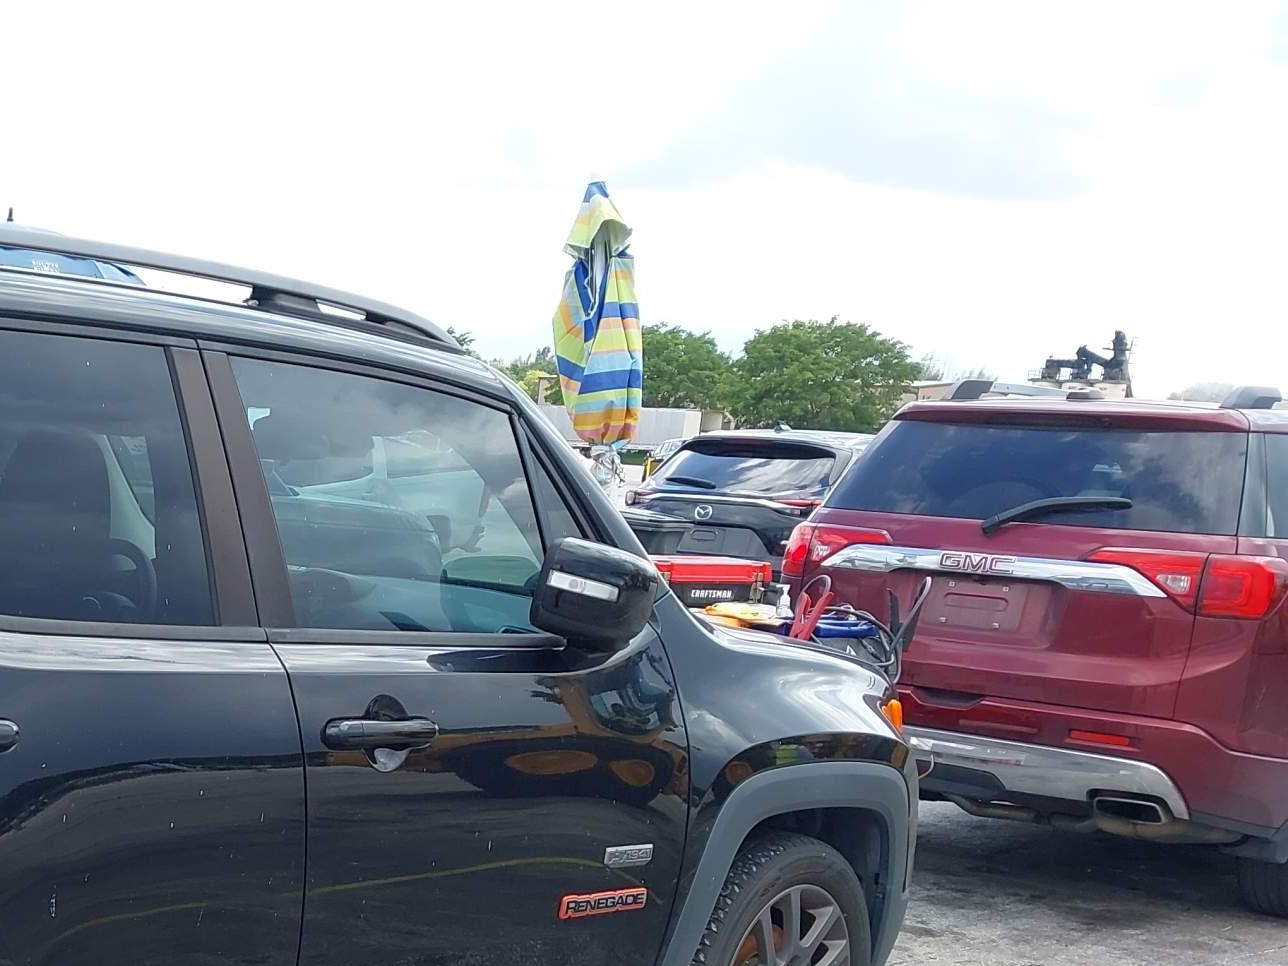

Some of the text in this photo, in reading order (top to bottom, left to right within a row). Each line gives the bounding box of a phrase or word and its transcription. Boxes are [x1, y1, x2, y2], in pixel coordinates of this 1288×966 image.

[940, 552, 1015, 575] GMC
[690, 588, 733, 599] CRAFTSMAN
[565, 892, 646, 915] RENEGADE
